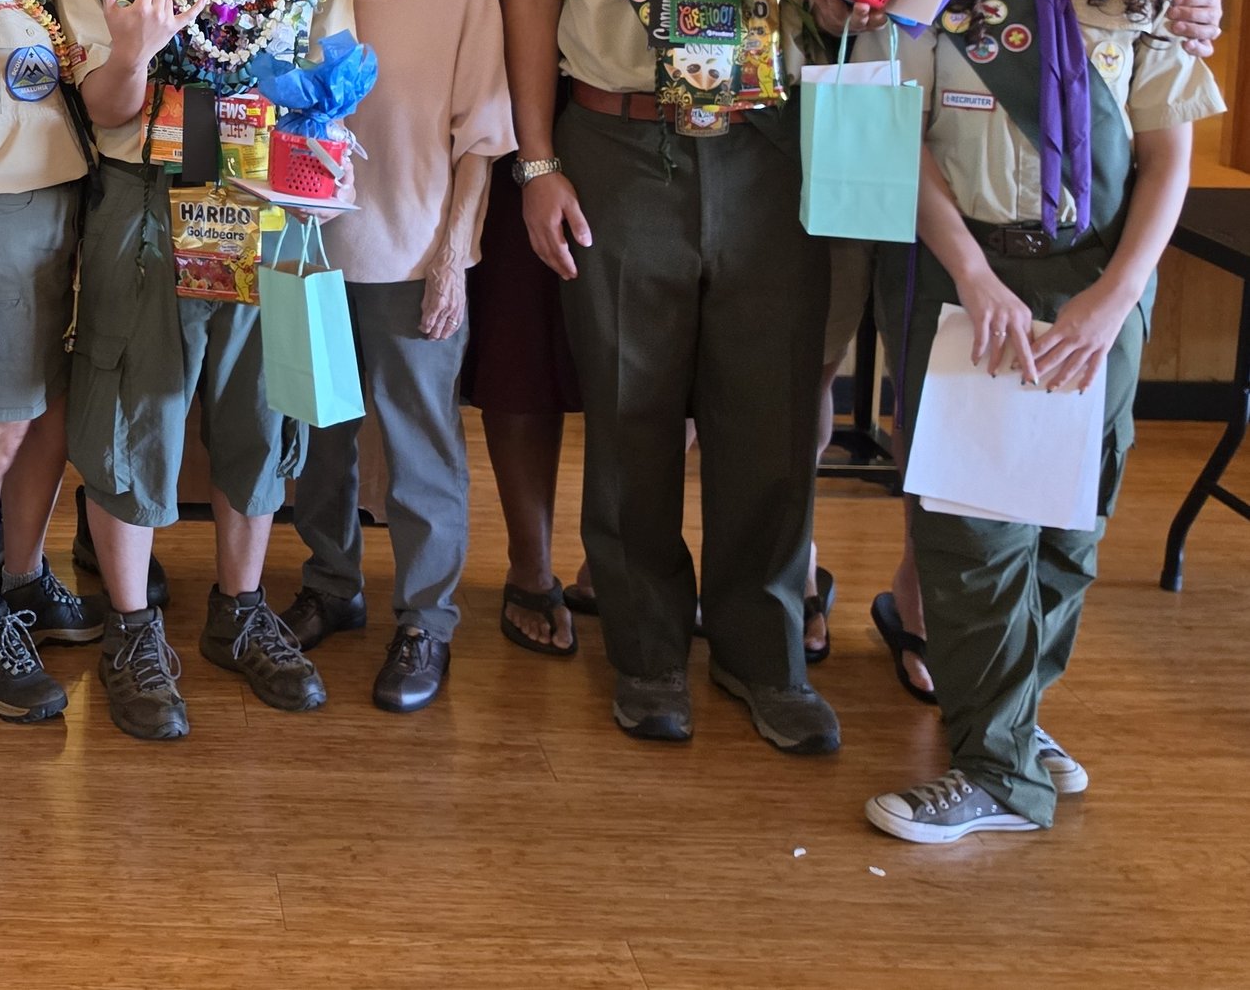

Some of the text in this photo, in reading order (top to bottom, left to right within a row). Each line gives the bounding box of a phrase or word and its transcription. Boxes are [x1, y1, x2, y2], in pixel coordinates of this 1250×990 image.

[678, 5, 734, 35] CHEEHOO!
[11, 55, 24, 76] SCOUT
[40, 52, 54, 68] CAMP
[950, 95, 992, 106] RECRUITER
[181, 204, 251, 225] HARIBO
[187, 226, 245, 240] Goldbears
